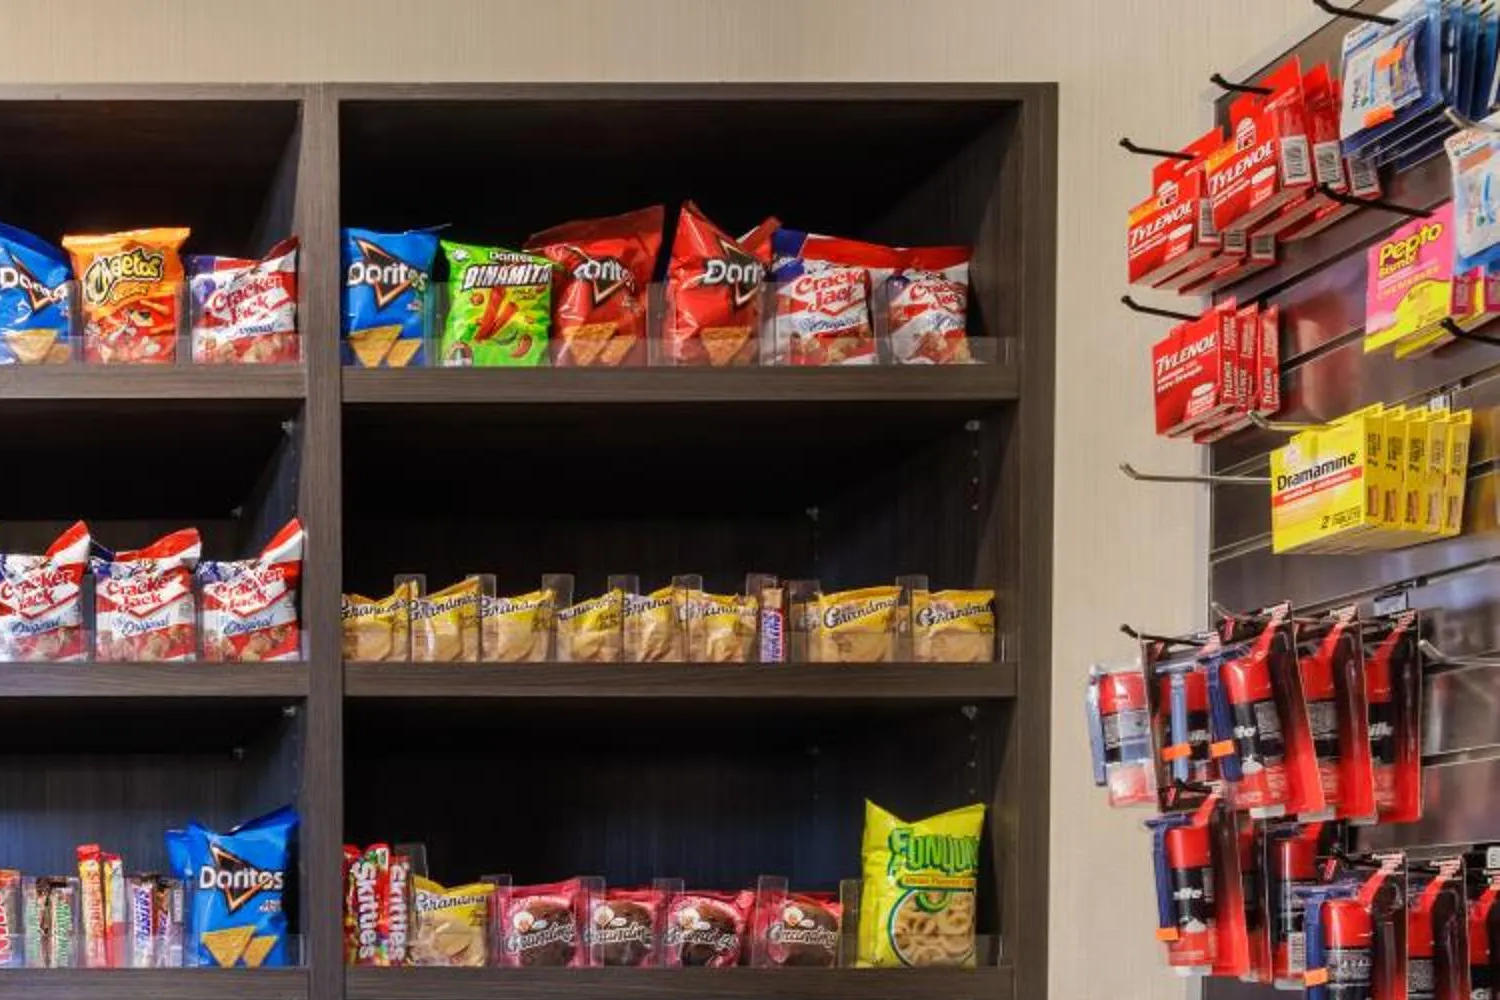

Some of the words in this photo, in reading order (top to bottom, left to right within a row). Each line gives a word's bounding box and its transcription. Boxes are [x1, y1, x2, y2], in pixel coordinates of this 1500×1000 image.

[1209, 141, 1274, 194] TYLENOL
[1128, 201, 1193, 246] TYLENOL
[84, 248, 162, 303] Cheetos
[346, 261, 428, 292] Doritos
[1155, 333, 1217, 376] TYLENOL
[1276, 451, 1357, 490] Dramamine
[2, 569, 73, 601] Cracker
[106, 568, 177, 597] Cracker
[214, 568, 285, 598] Cracker
[117, 592, 163, 613] Jack
[223, 614, 274, 636] Original
[888, 827, 979, 876] FUNYUN
[200, 866, 284, 890] Doritos
